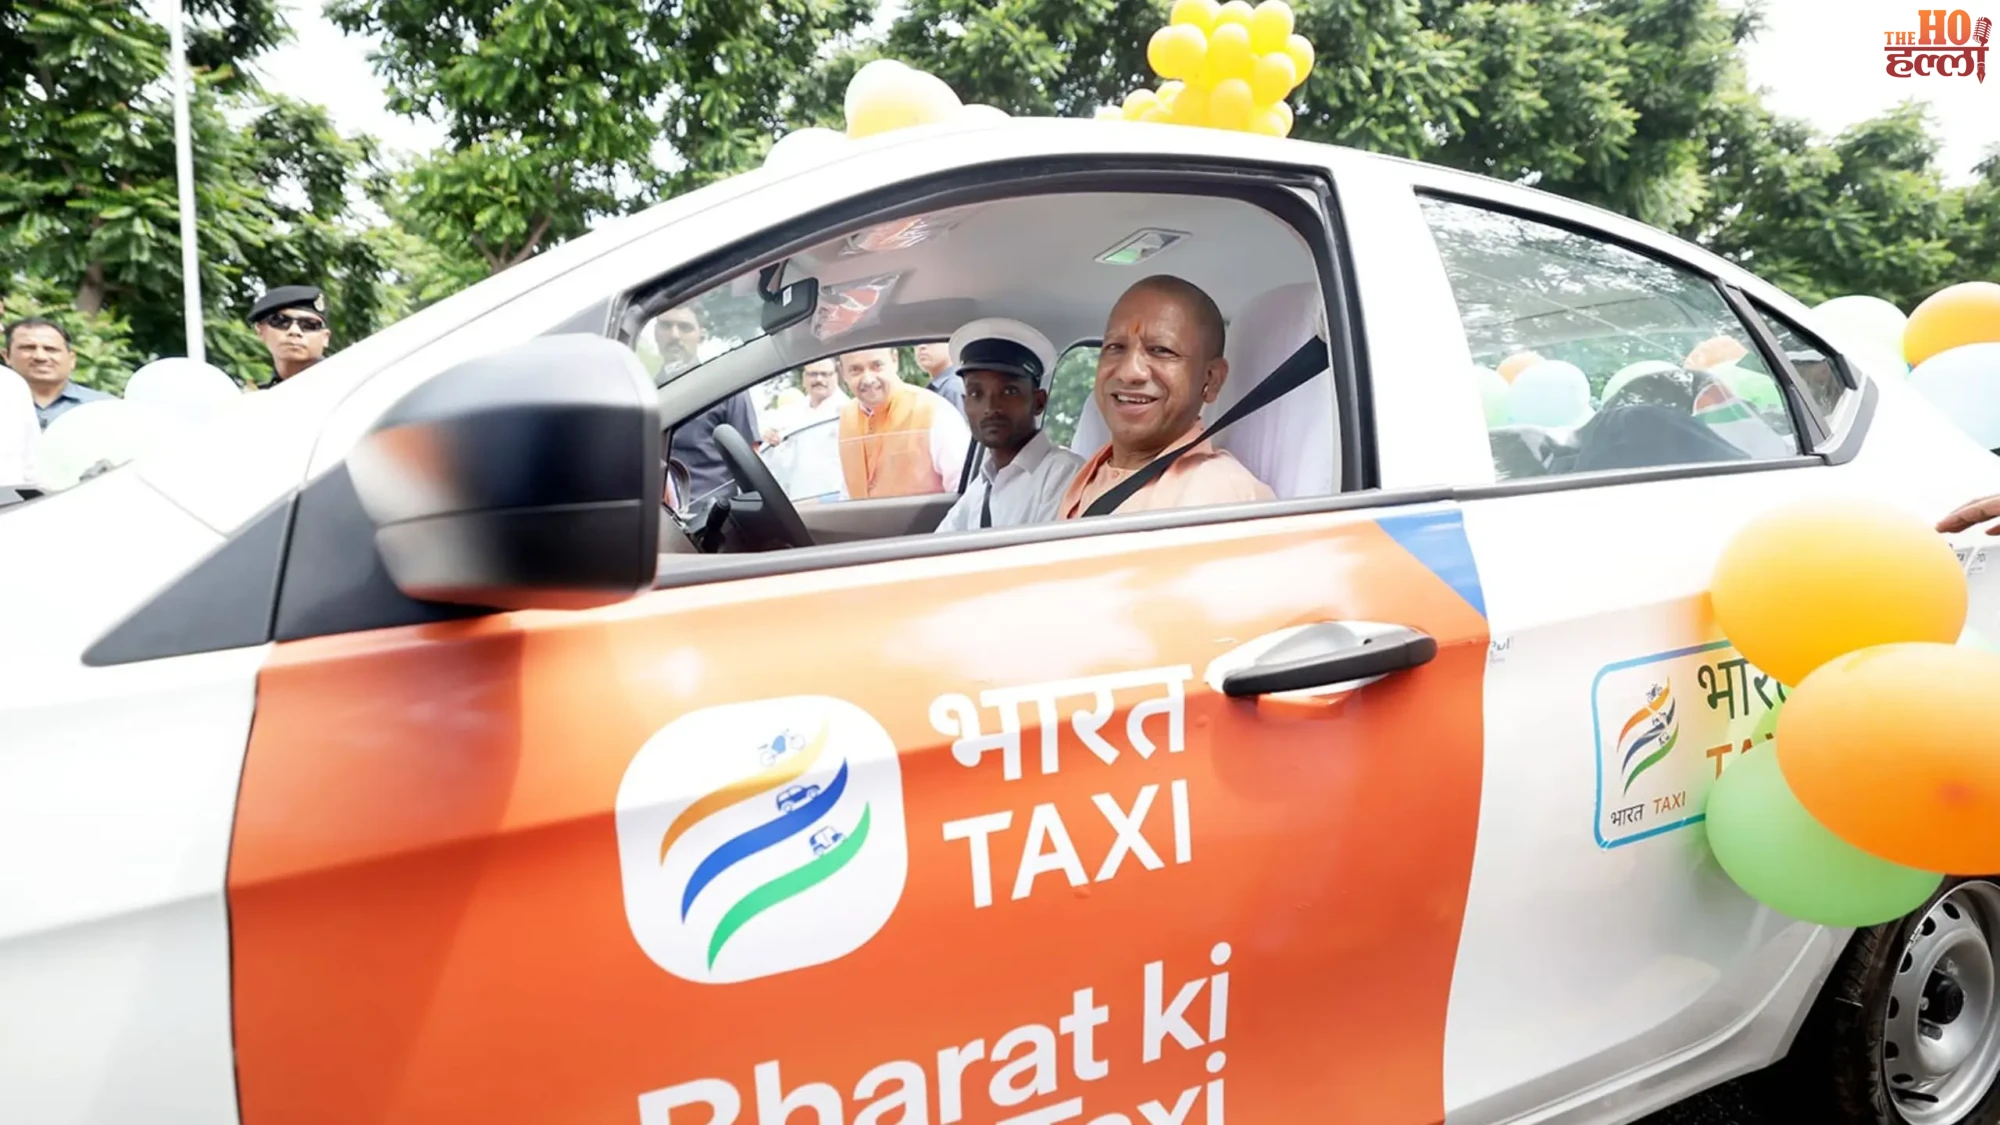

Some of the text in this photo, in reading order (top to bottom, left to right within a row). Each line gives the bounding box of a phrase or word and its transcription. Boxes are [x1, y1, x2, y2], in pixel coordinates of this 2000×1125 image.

[928, 663, 1193, 781] भारत
[942, 779, 1191, 909] TAXI
[1611, 803, 1645, 826] भारत
[1653, 790, 1686, 815] TAXI
[1143, 941, 1232, 1064] ki
